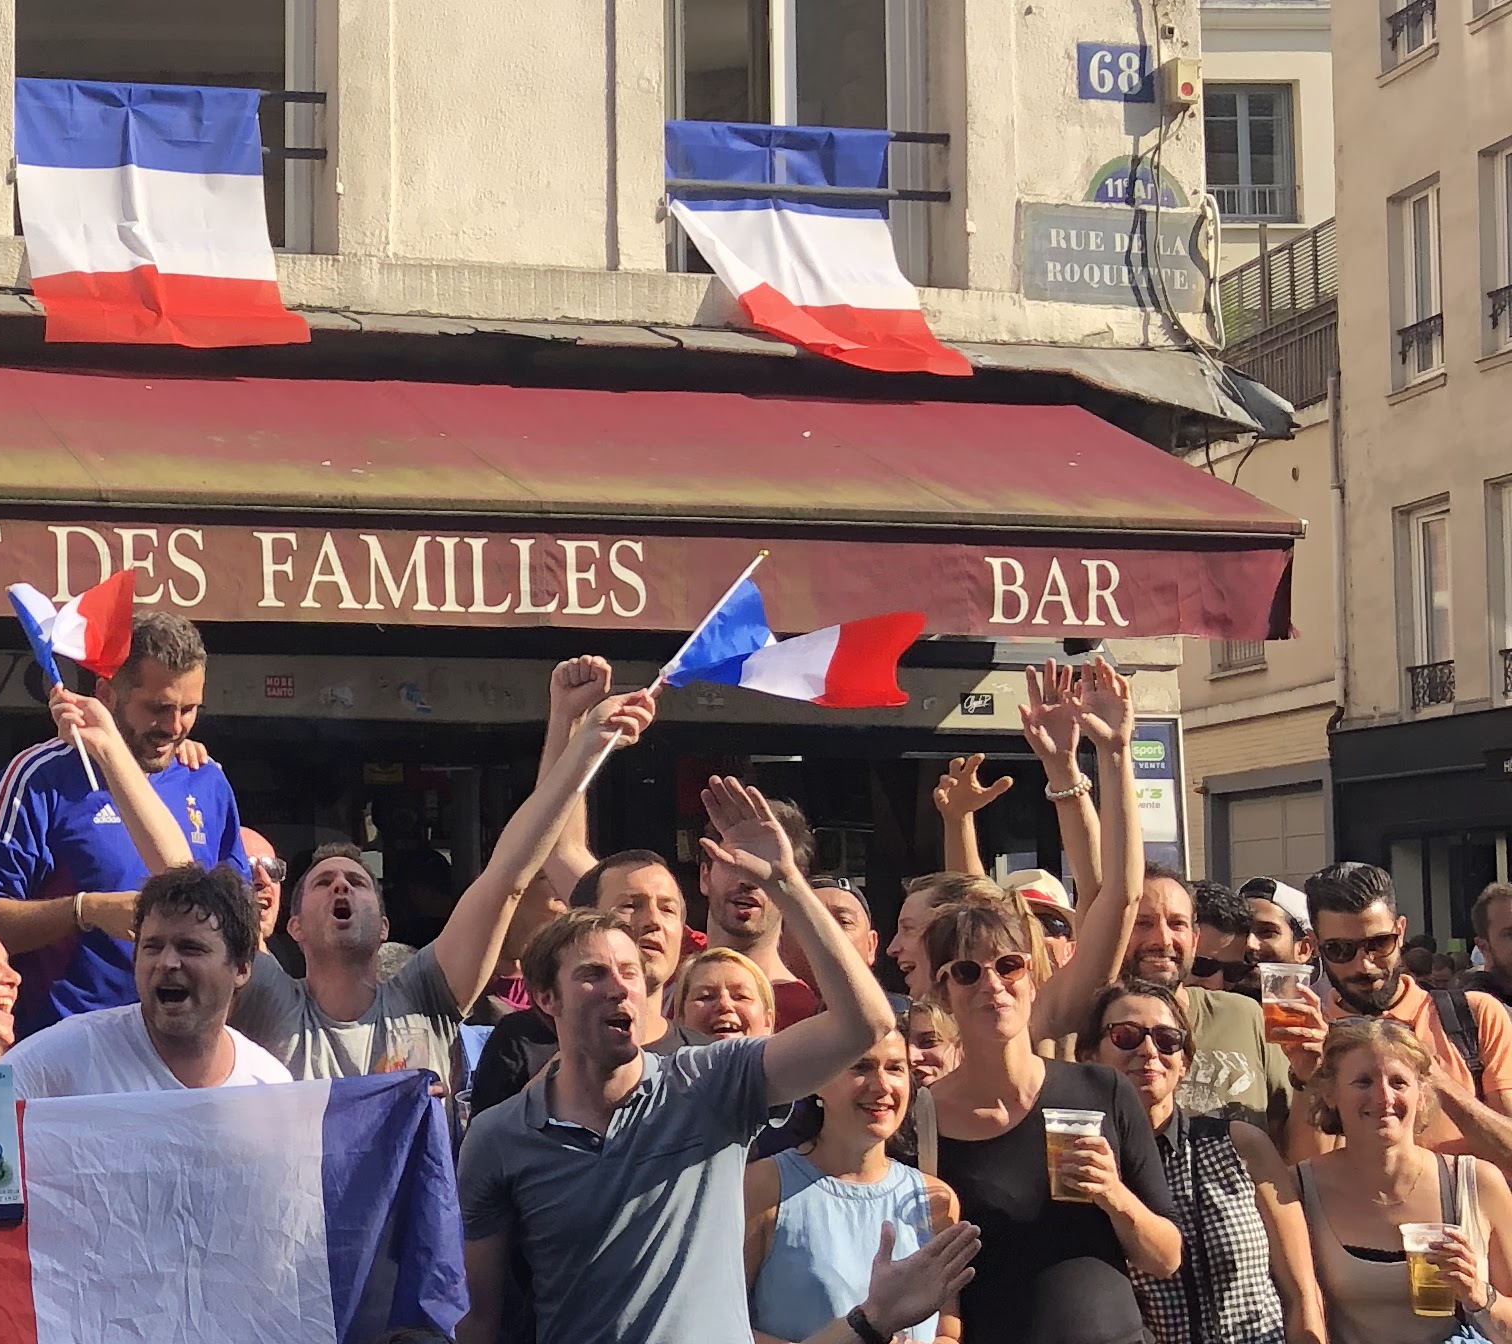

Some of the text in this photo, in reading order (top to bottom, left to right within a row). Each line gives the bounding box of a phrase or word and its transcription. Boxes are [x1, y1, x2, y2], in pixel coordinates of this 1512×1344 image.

[1089, 50, 1142, 94] 68
[1049, 228, 1188, 256] RUE DE LA
[47, 525, 207, 606] DES
[252, 531, 646, 617] FAMILLES
[985, 557, 1129, 627] BAR
[1133, 745, 1164, 757] sport
